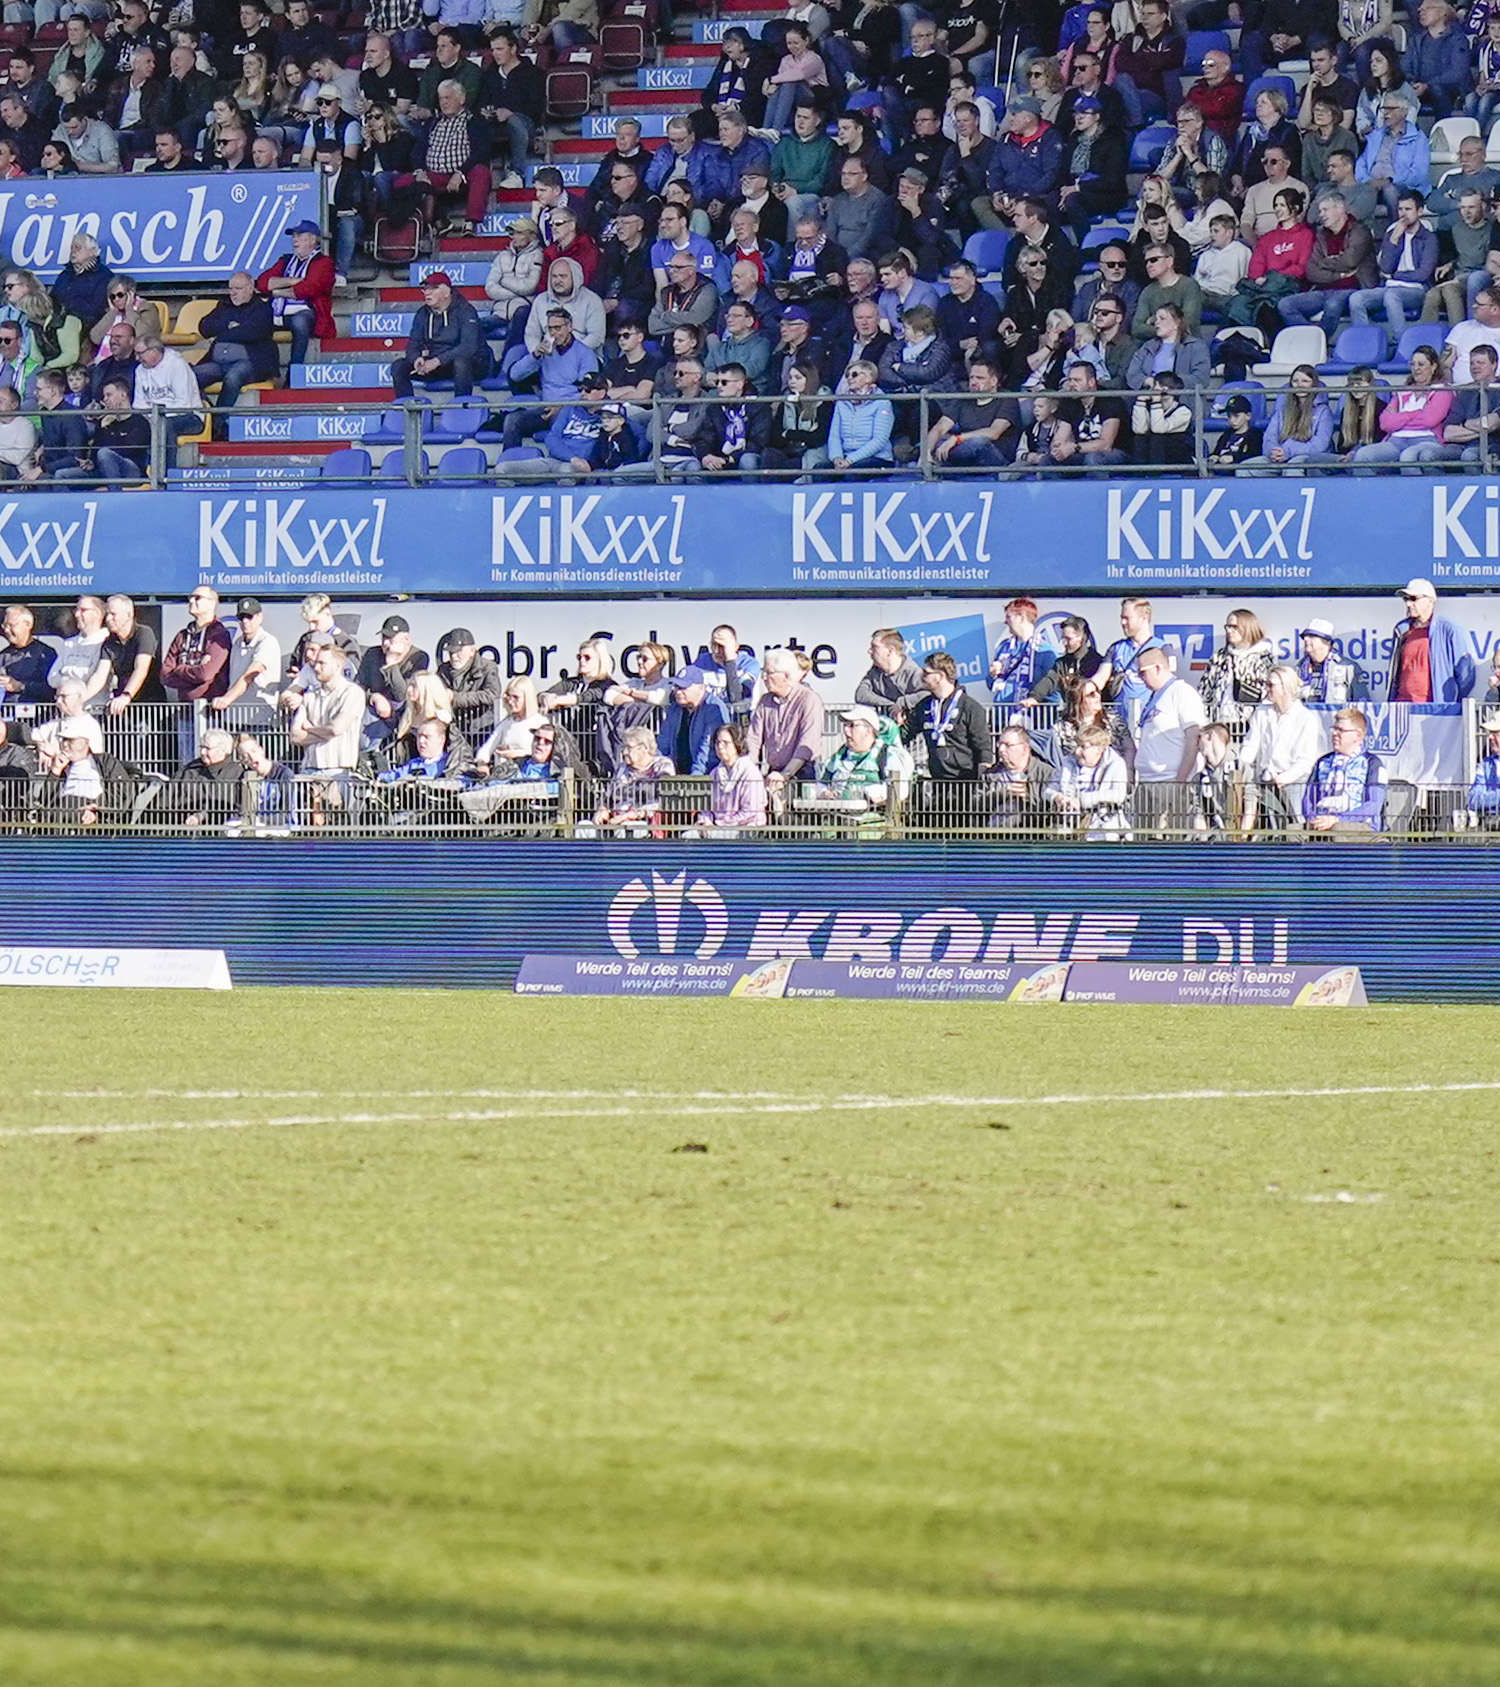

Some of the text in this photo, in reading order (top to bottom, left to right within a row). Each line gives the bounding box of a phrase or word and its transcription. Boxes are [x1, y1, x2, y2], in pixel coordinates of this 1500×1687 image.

[646, 69, 693, 87] KiKxxl
[355, 314, 404, 334] KiKxxl
[305, 364, 354, 383] KiKxxl
[244, 417, 293, 436] KiKxxl
[317, 417, 367, 436] KiKxxl
[491, 494, 686, 565] KiKxxl
[792, 491, 994, 563] KiKxxl
[1107, 487, 1316, 560] KiKxxl
[199, 498, 387, 568] KiKxxl
[491, 569, 682, 582] Ihr Kommunikationsdienstleister
[793, 566, 990, 580] Ihr Kommunikationsdienstleister
[1107, 564, 1312, 578] Ihr Kommunikationsdienstleister
[1433, 561, 1451, 576] Ihr
[745, 908, 1140, 963] KRONE
[576, 962, 734, 977] Werde Teil des Teams!
[849, 966, 1011, 981] Werde Teil des Teams!
[1129, 968, 1296, 985] Werde Teil des Teams!
[621, 978, 727, 991] www.pkf-wms.de
[897, 982, 1005, 995] www.pkf-wms.de
[1178, 985, 1291, 998] www.pkf-wms.de
